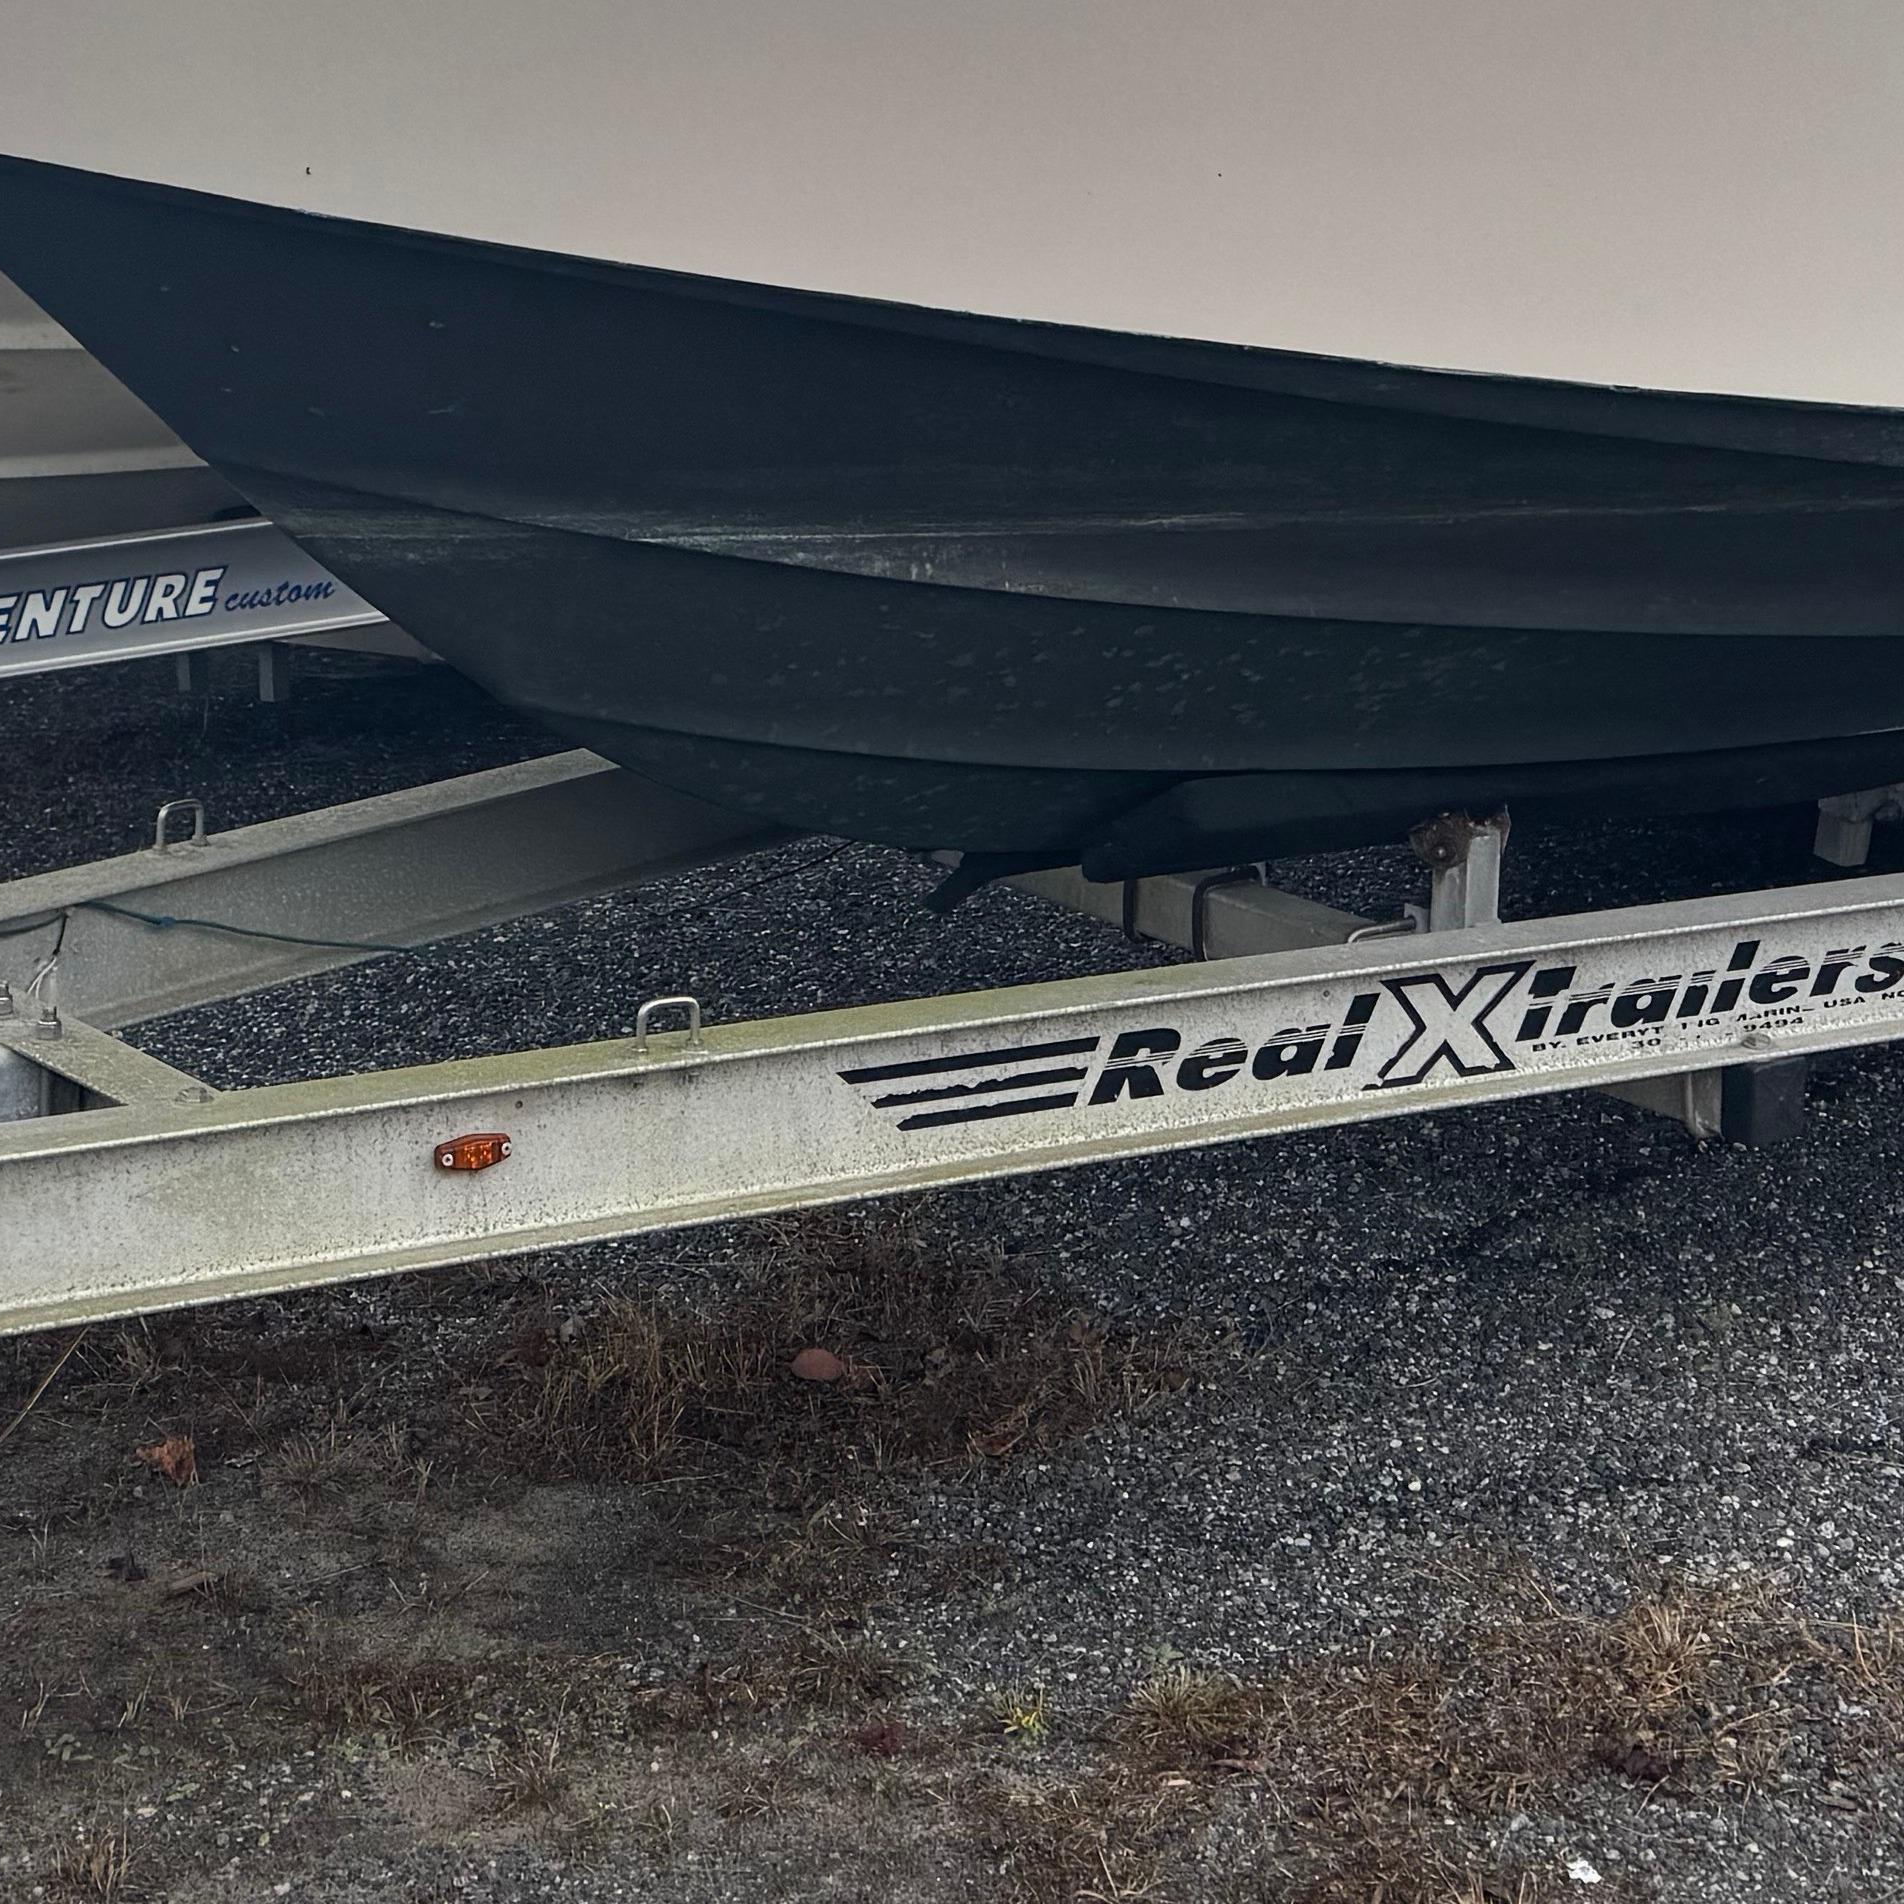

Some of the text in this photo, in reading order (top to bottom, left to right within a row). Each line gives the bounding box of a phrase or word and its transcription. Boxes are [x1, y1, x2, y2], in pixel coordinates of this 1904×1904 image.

[225, 579, 335, 612] custom
[1823, 996, 1866, 1008] USA
[1087, 992, 1381, 1106] Real
[1364, 960, 1536, 1090] X
